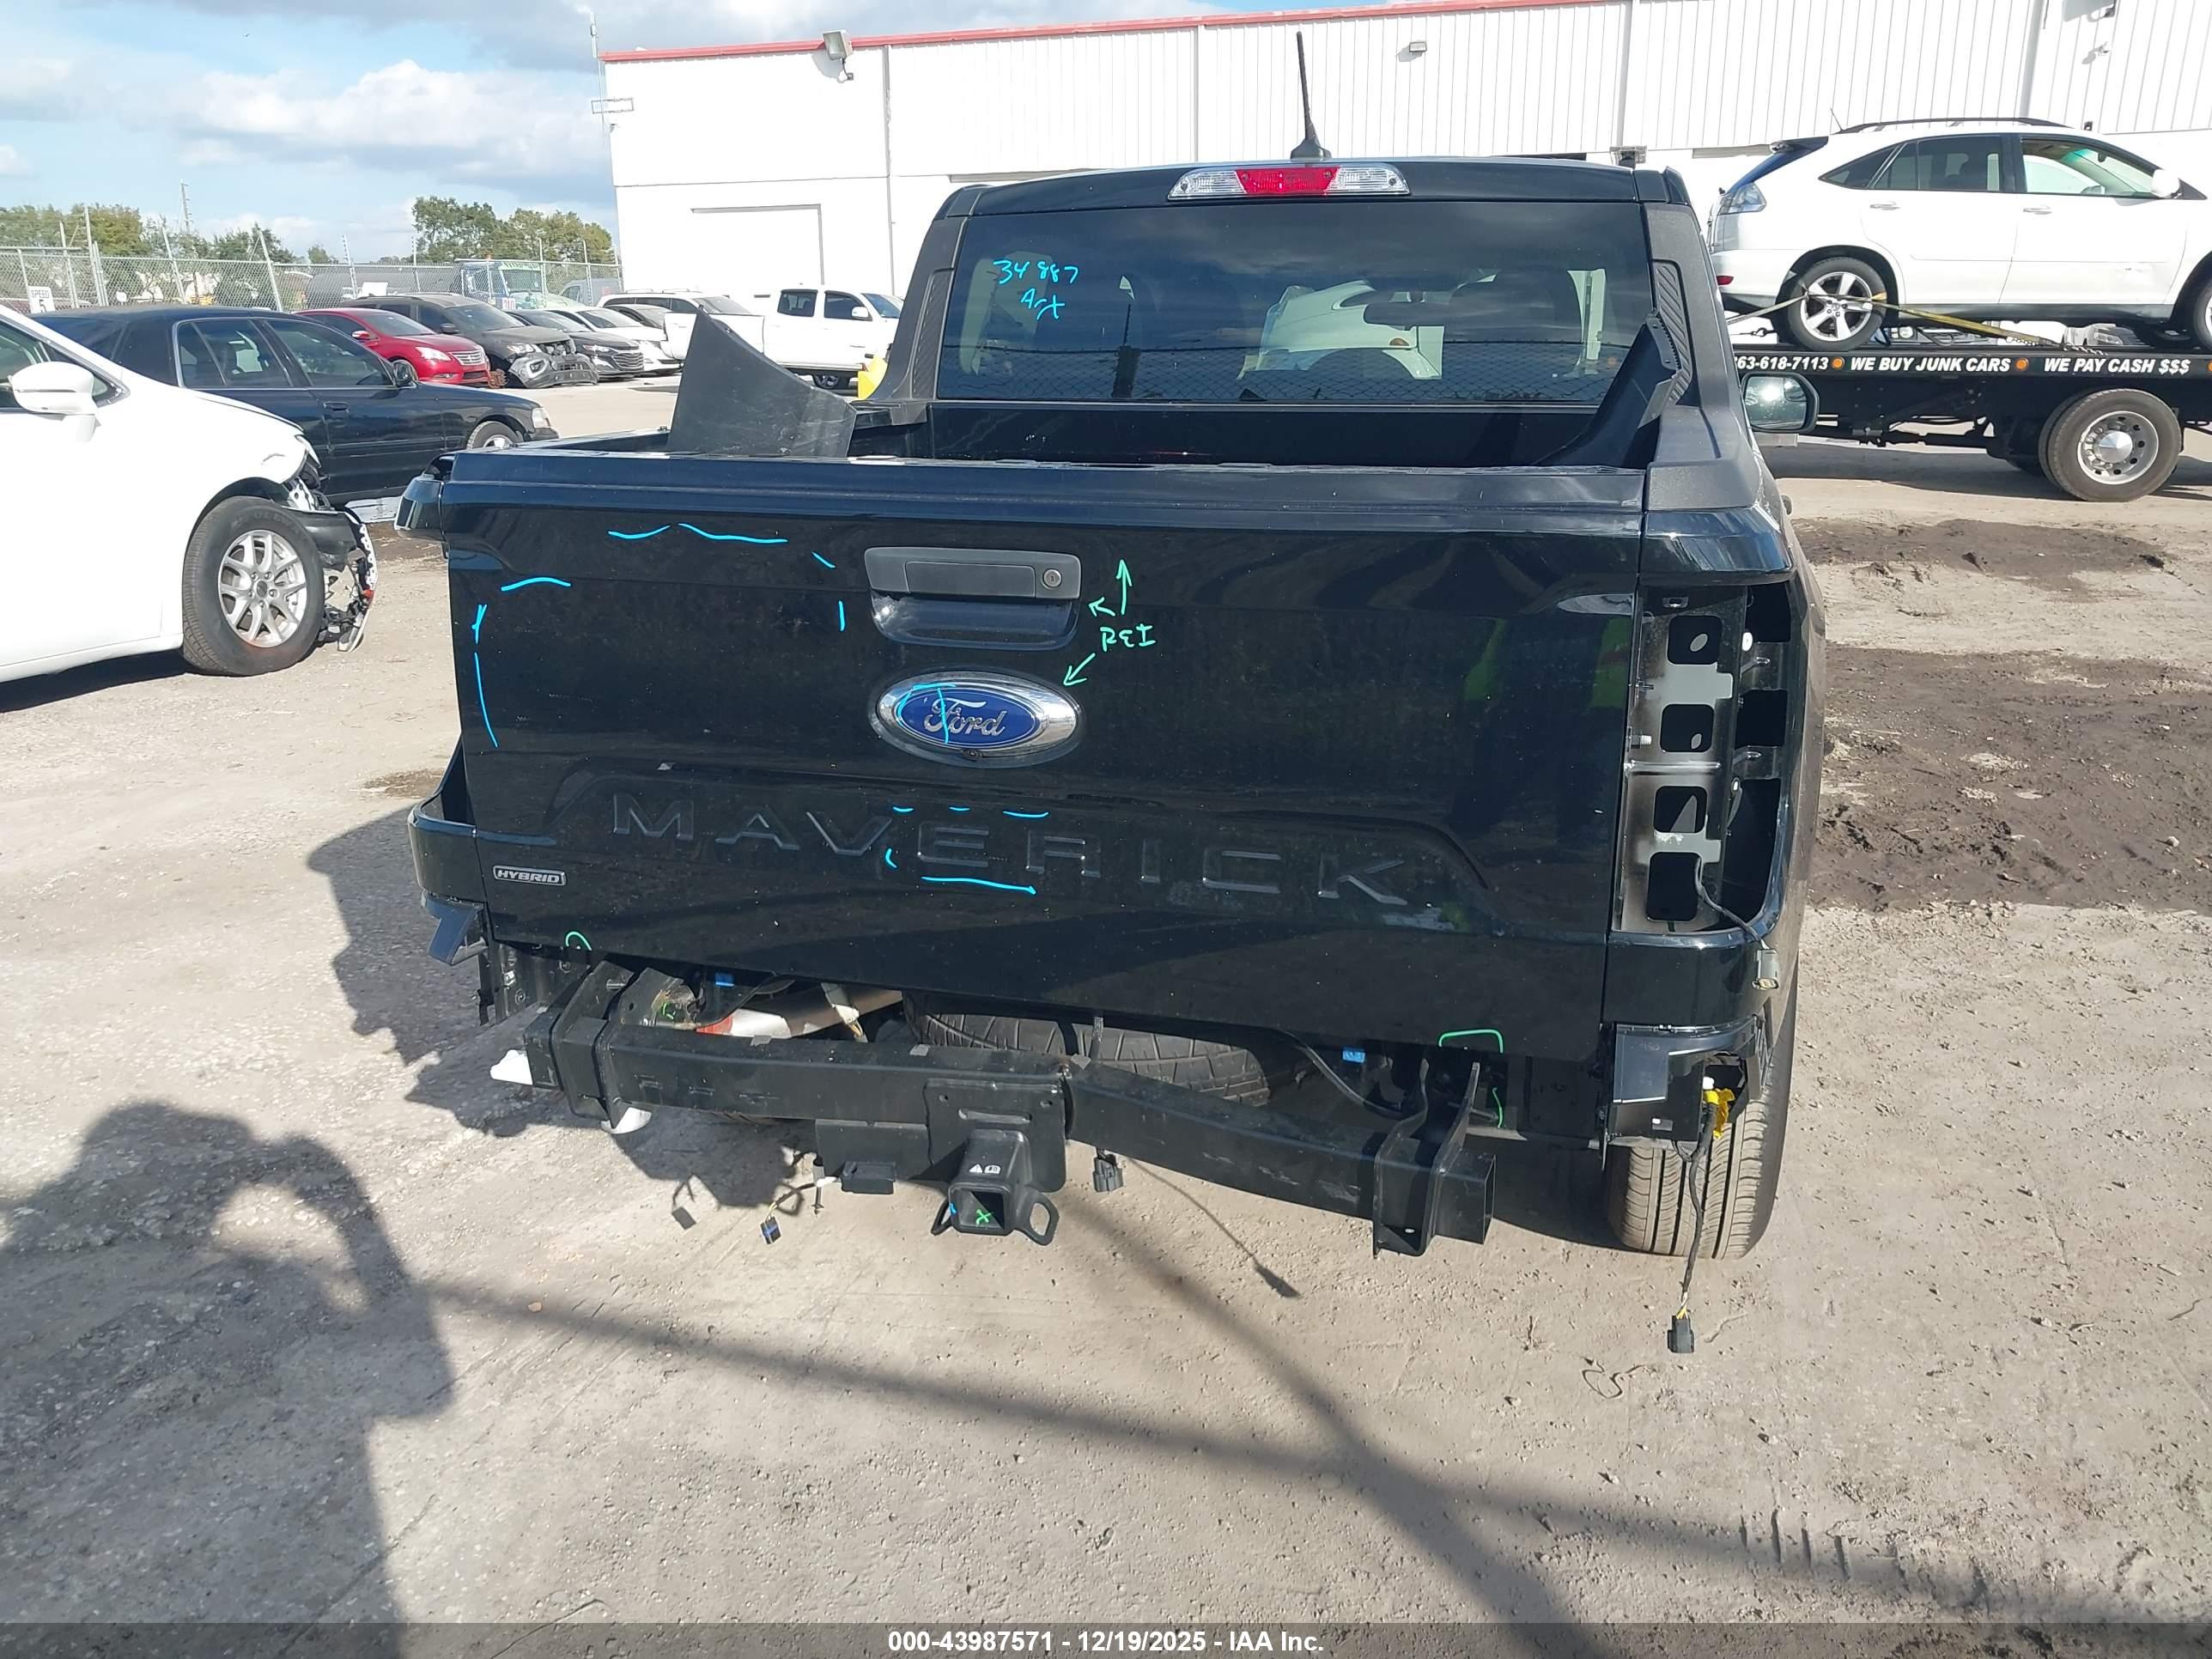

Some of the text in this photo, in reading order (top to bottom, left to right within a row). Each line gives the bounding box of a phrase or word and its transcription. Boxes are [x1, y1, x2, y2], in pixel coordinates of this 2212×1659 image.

[1735, 356, 1829, 370] 63-618-7113
[1850, 356, 2011, 372] WE BUY JUNK CARS
[2044, 357, 2191, 375] WE PAY CASH $$$
[923, 697, 1007, 738] Ford
[611, 791, 1410, 906] MAVERICK
[497, 869, 561, 884] HYBRID
